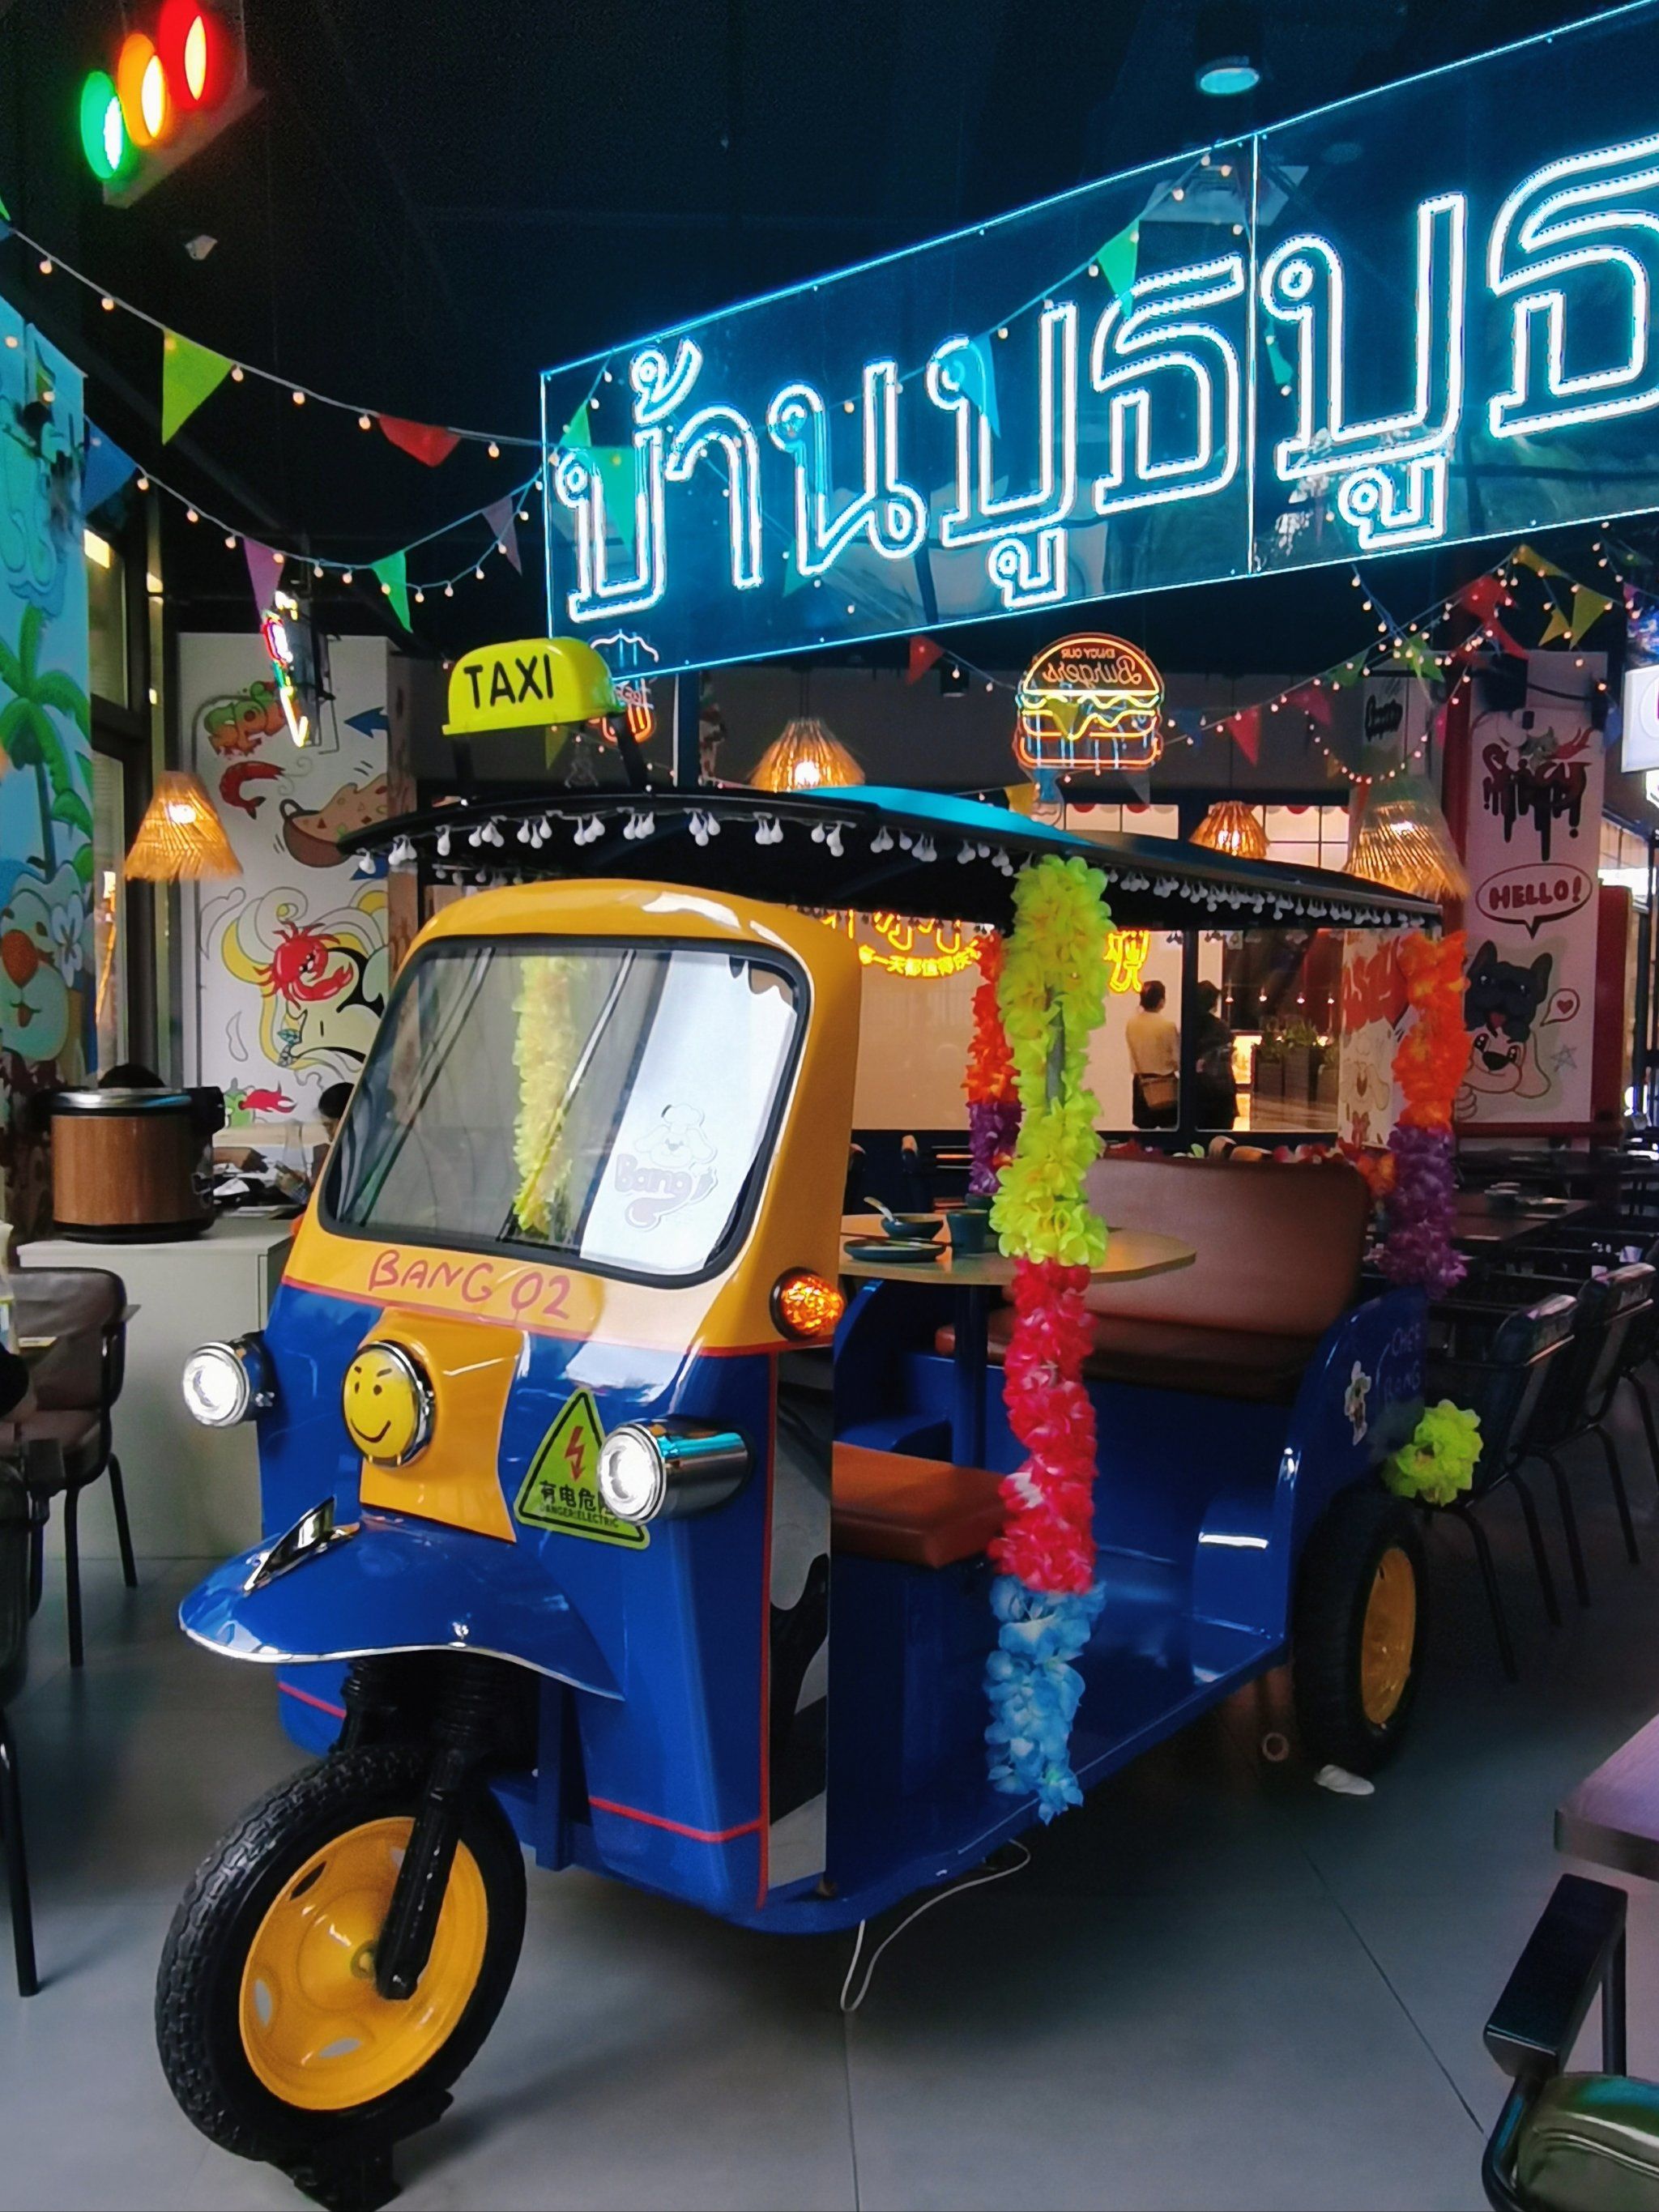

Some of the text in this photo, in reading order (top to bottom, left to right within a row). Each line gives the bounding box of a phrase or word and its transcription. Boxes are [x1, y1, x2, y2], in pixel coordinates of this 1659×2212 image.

[463, 653, 553, 710] TAXI
[1489, 876, 1582, 910] HELLO!
[369, 1249, 571, 1319] BANG 02
[539, 1480, 612, 1517] 有电危
